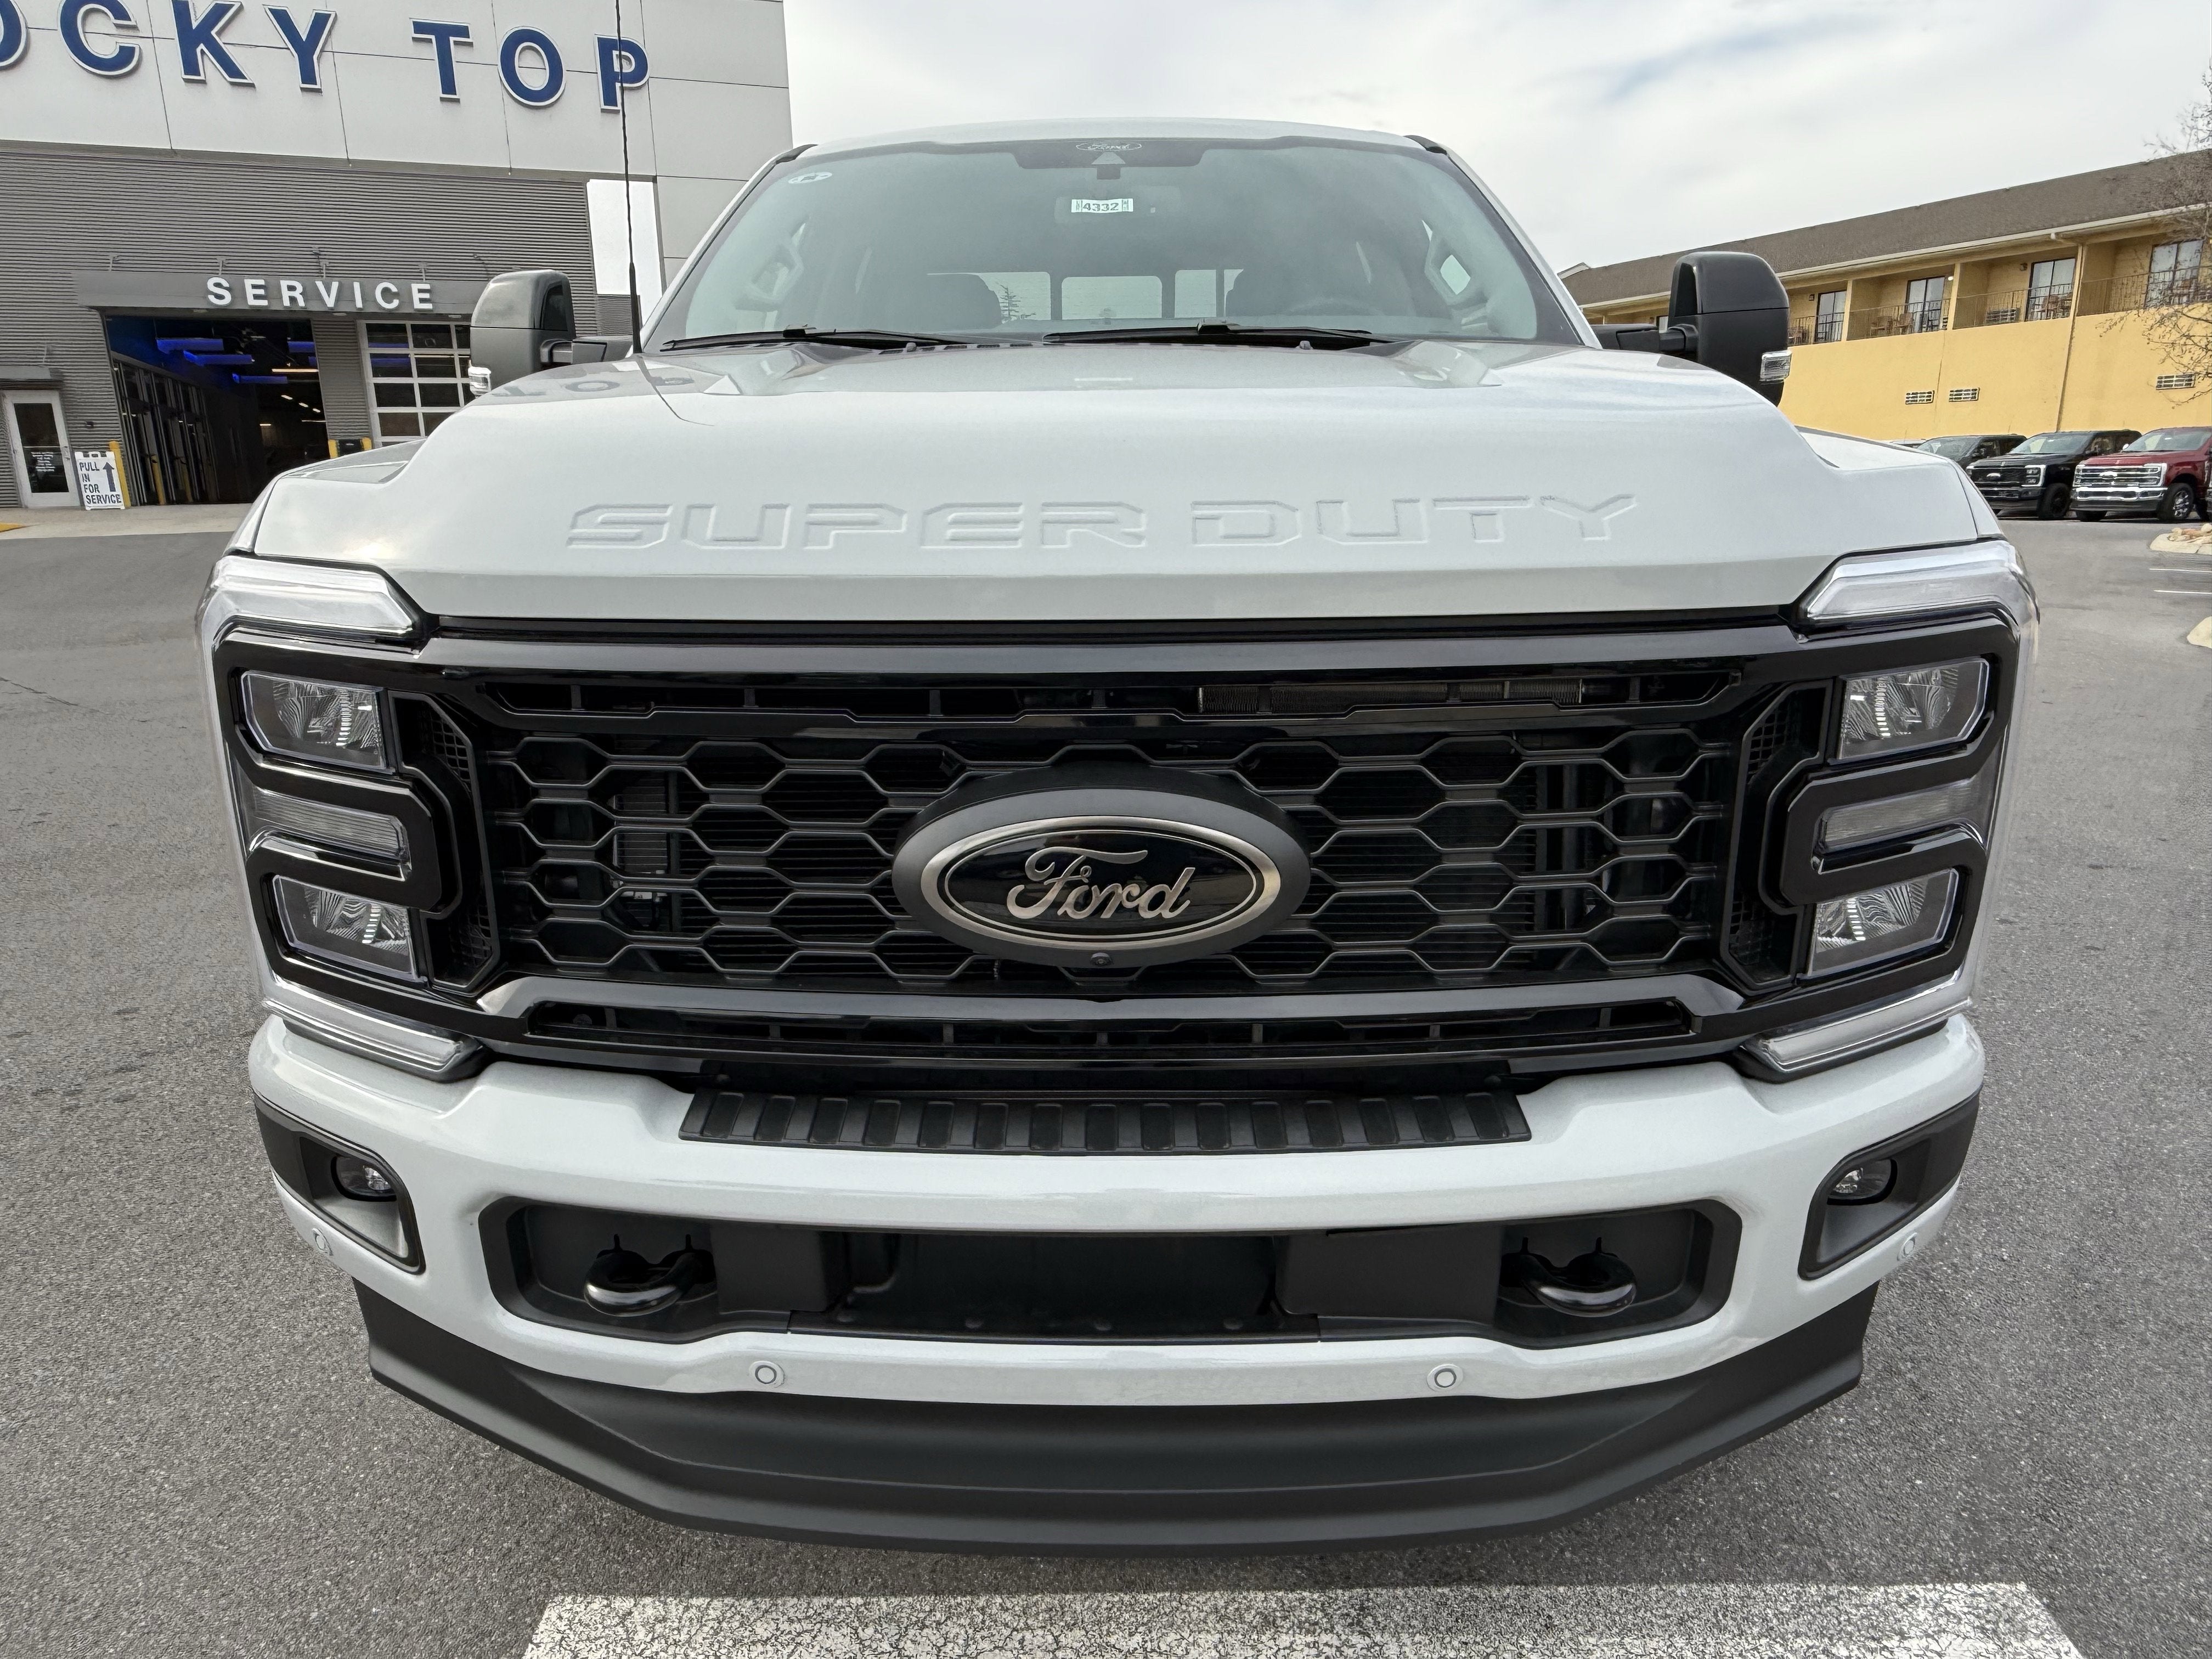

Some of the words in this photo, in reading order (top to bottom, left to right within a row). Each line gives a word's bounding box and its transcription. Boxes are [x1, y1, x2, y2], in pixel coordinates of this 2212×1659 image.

[410, 18, 651, 112] TOP
[1082, 202, 1119, 211] 4332
[207, 276, 433, 311] SERVICE
[79, 461, 100, 471] PULL
[82, 473, 90, 482] IN
[83, 484, 100, 493] FOR
[86, 494, 122, 504] SERVICE
[565, 501, 1147, 549] SUPER
[1191, 493, 1637, 546] DUTY
[1006, 846, 1196, 919] Ford
